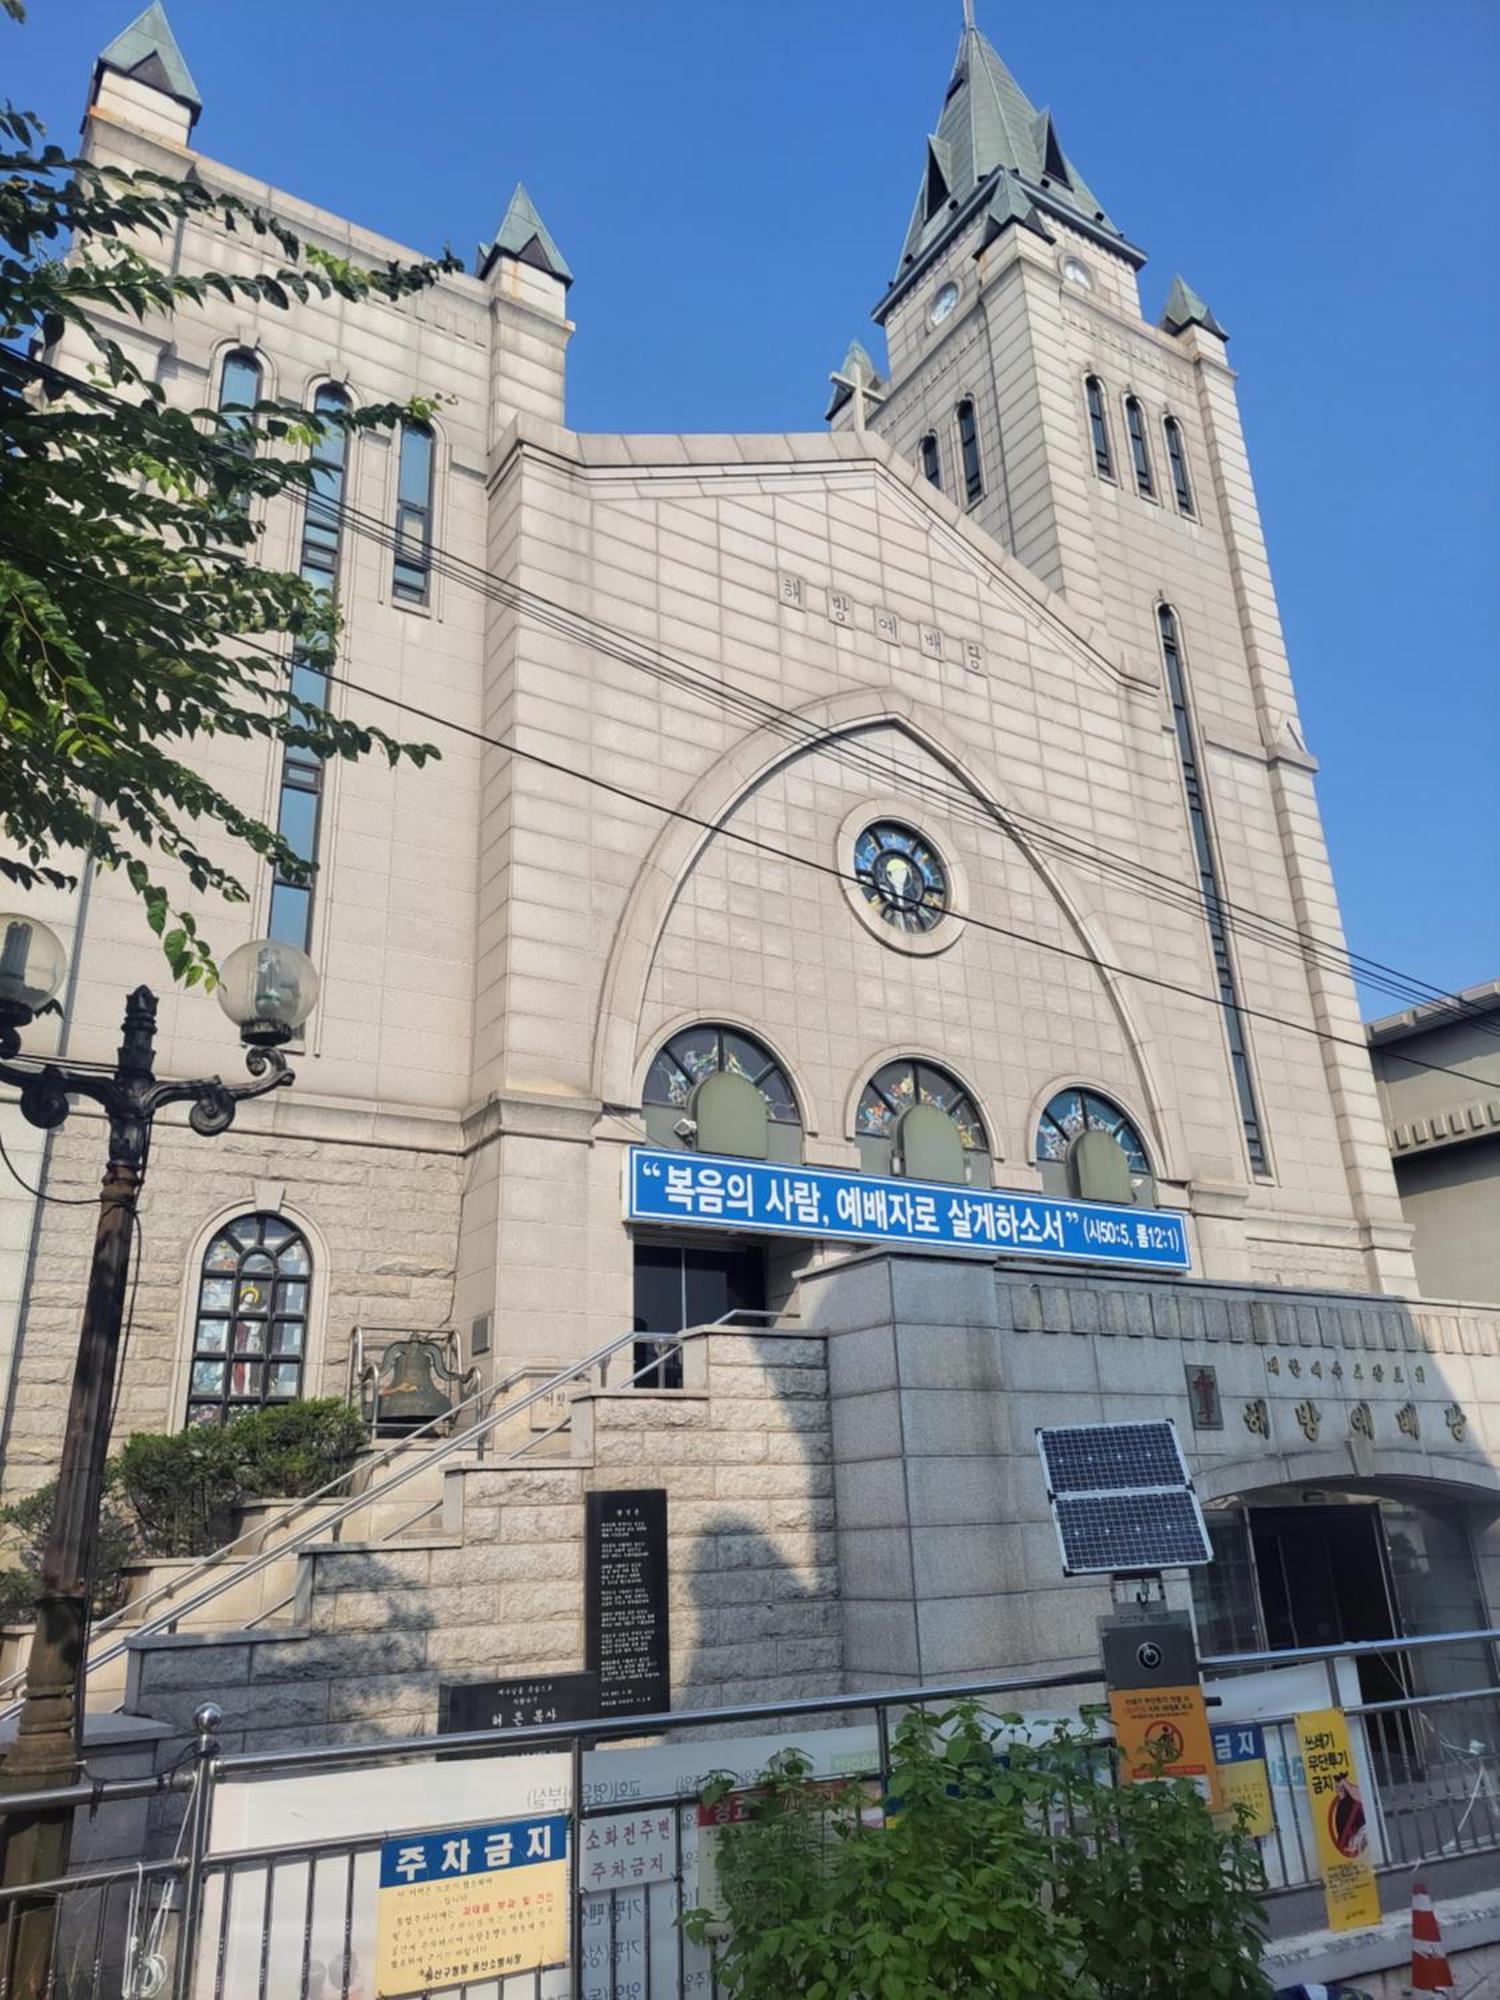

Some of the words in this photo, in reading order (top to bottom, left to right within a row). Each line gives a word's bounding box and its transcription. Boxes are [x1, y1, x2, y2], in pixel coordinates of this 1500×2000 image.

[784, 578, 983, 671] 해방예배당
[642, 1161, 753, 1217] “복음의
[765, 1178, 829, 1227] 사람,
[836, 1187, 940, 1234] 예배자로
[948, 1198, 1079, 1248] 살게하소서”
[1305, 1731, 1335, 1751] 쓰레기
[1308, 1750, 1349, 1774] 무단투기
[1312, 1774, 1335, 1795] 금지
[396, 1825, 552, 1882] 주차금지
[590, 1852, 664, 1883] 주차금지
